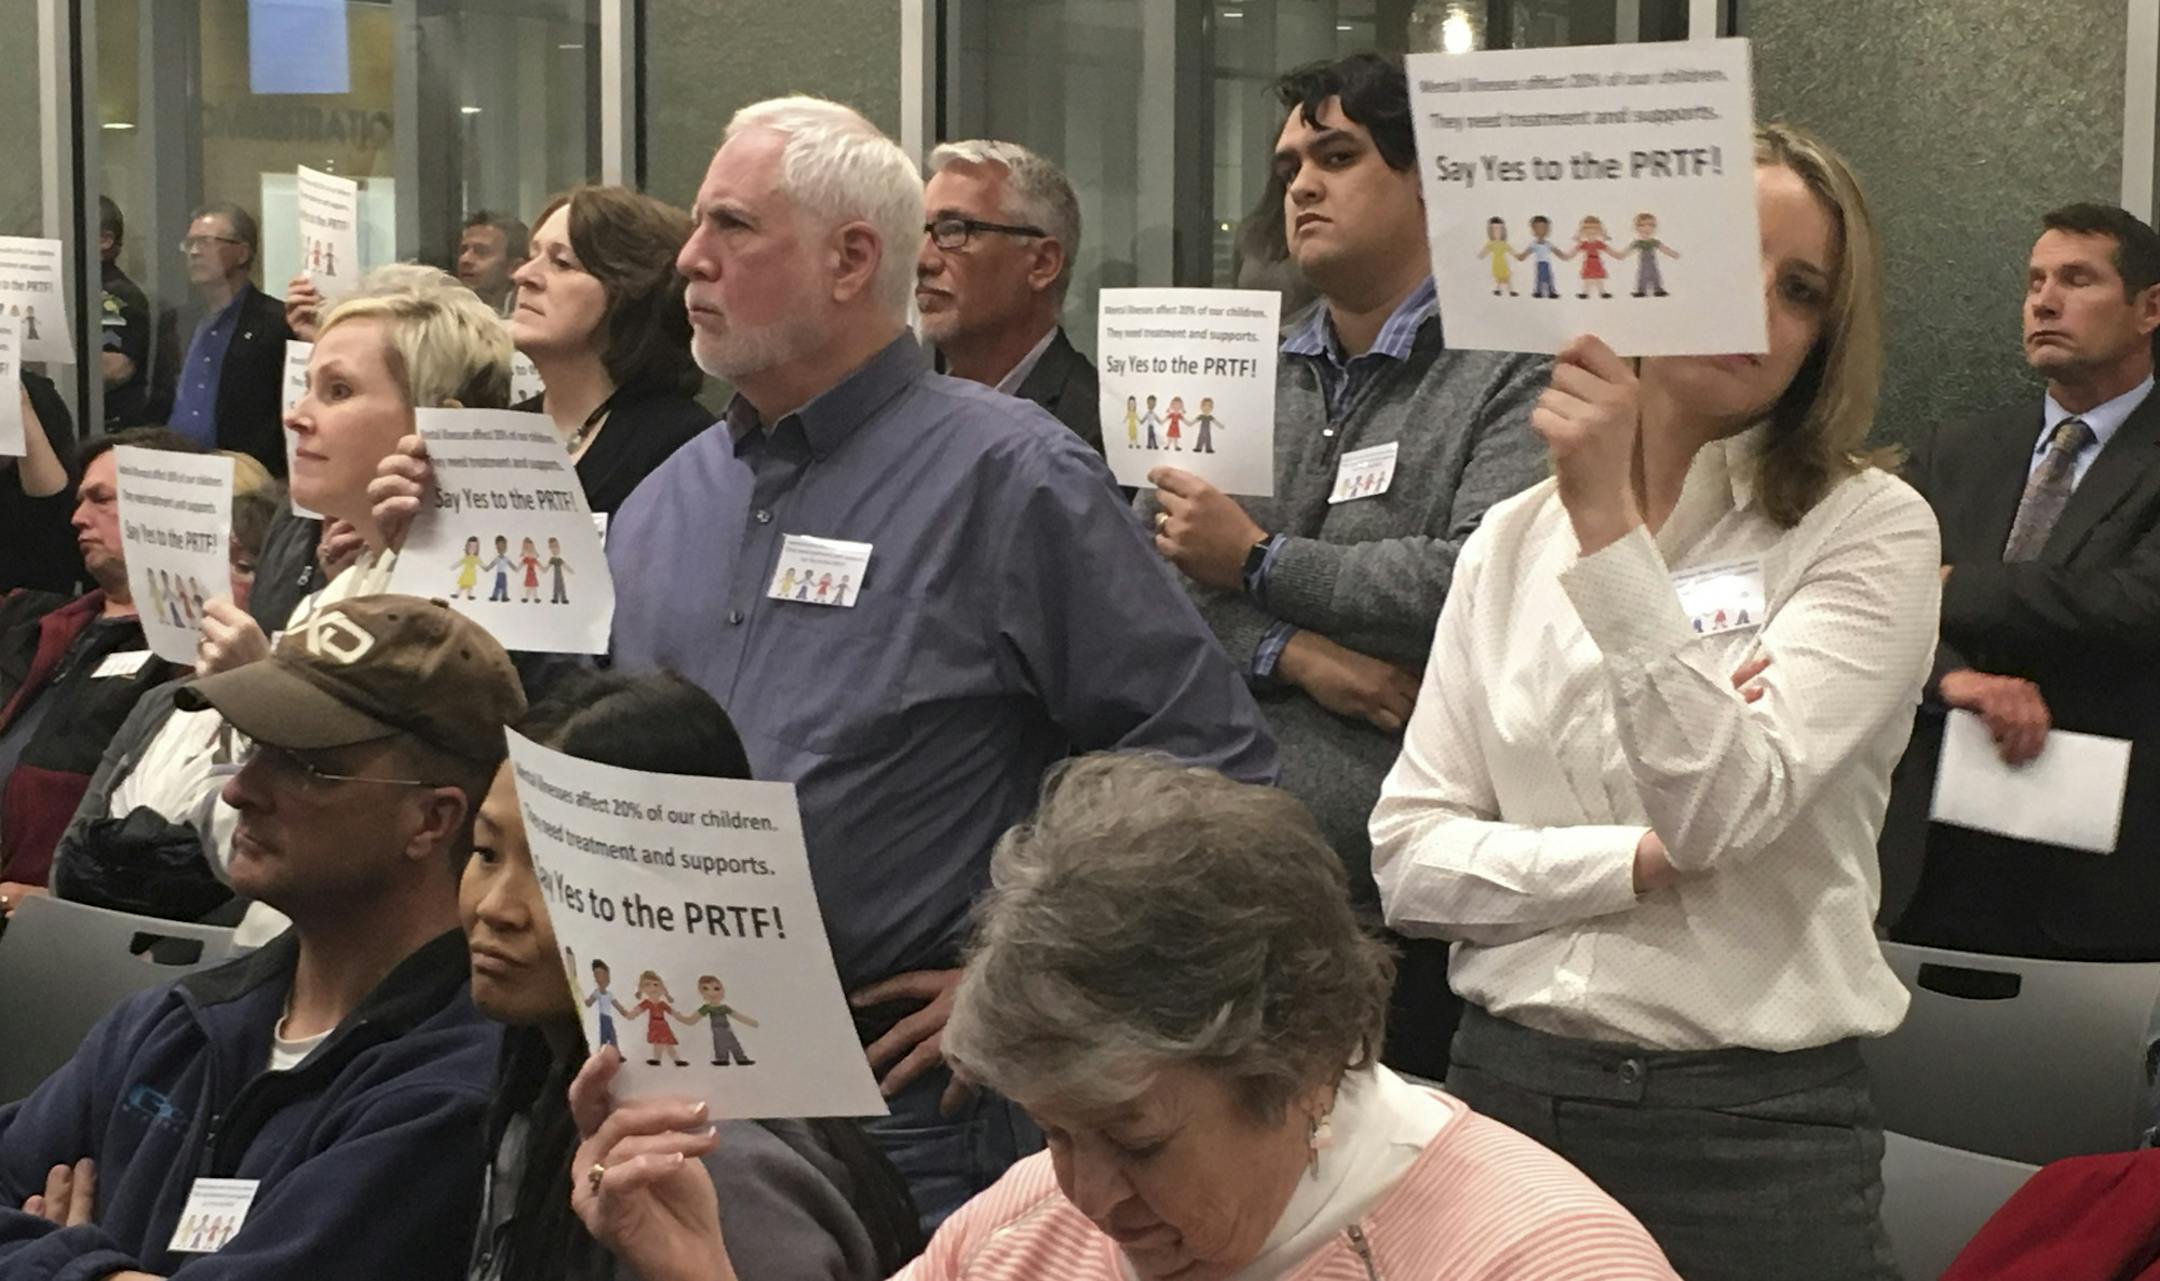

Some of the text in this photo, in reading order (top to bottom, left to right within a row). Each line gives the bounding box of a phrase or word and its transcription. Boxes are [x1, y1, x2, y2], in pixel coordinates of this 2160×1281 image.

[1436, 145, 1723, 188] Say Yes to the PRTF!
[1106, 355, 1257, 378] Say Yes to the PRTF!
[434, 487, 579, 514] Say Yes to the PRTF!
[168, 528, 184, 550] the
[186, 530, 217, 554] PRTF!
[576, 790, 612, 815] affect
[613, 799, 643, 820] 20%
[647, 804, 664, 822] of
[667, 809, 696, 825] our
[701, 809, 779, 832] children.
[566, 829, 638, 862] treatment
[642, 847, 675, 867] and
[681, 852, 776, 876] supports.
[554, 870, 585, 914] Yes
[589, 888, 616, 923] to
[622, 893, 675, 932] the
[684, 901, 787, 940] PRTF!
